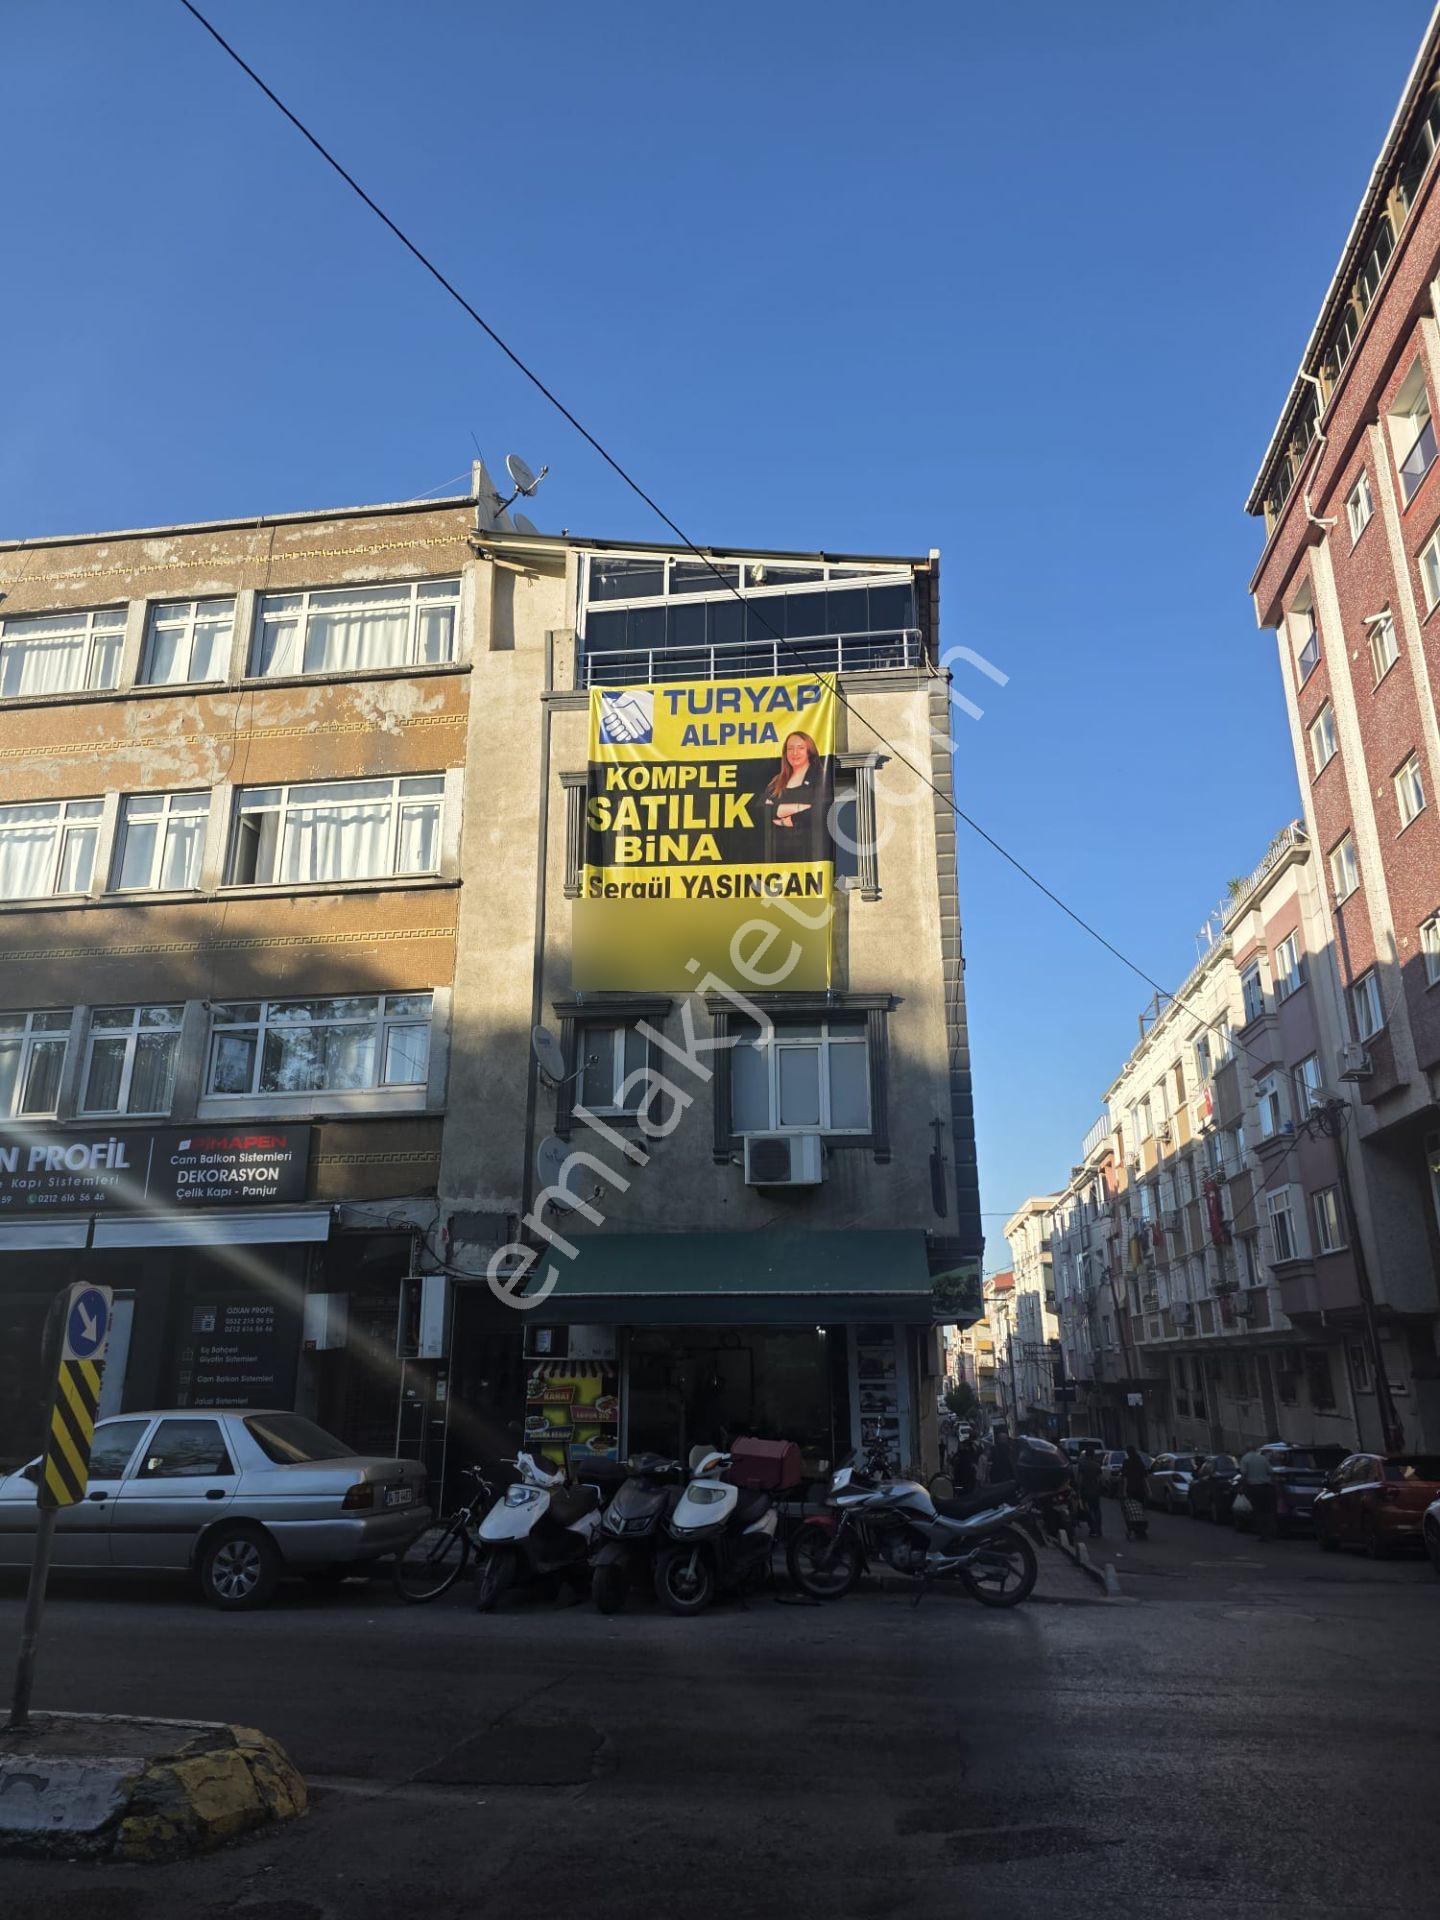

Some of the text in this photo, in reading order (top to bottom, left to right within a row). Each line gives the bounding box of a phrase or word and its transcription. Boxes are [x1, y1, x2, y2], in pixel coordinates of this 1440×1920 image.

[663, 684, 822, 716] TURYAP
[680, 721, 779, 747] ALPHA
[605, 764, 738, 791] KOMPLE
[587, 792, 755, 832] SATILIK
[680, 871, 823, 899] YASINGAN
[27, 1136, 131, 1172] PROFİL
[170, 1151, 292, 1165] Cam Balkon Sistemleri
[48, 1174, 120, 1187] Sistemleri
[177, 1167, 280, 1184] DEKORASYON
[176, 1188, 204, 1200] Çelik
[242, 1185, 278, 1197] Panjur
